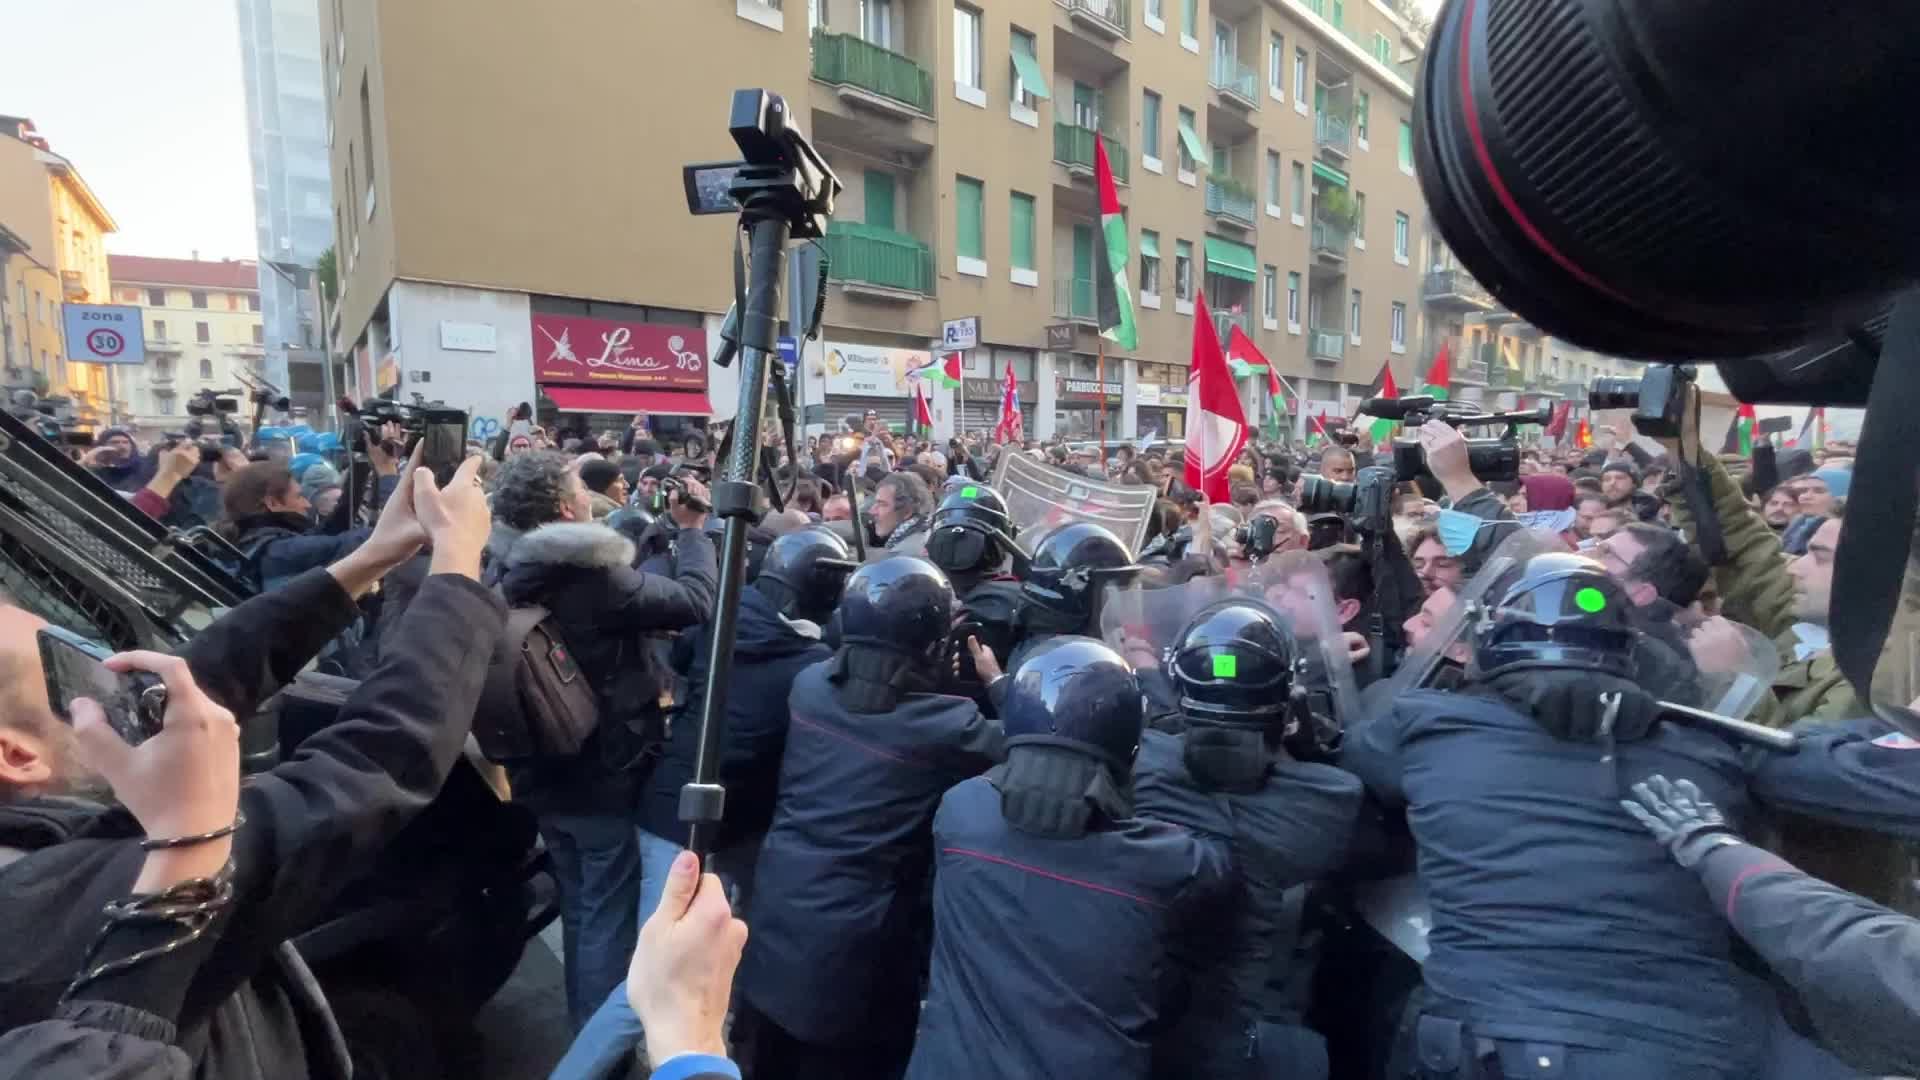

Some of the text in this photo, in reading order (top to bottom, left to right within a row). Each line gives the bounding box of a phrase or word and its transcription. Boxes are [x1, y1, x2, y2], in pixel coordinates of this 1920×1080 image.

[81, 311, 124, 321] zona
[95, 335, 117, 349] 30
[586, 327, 669, 371] Lima
